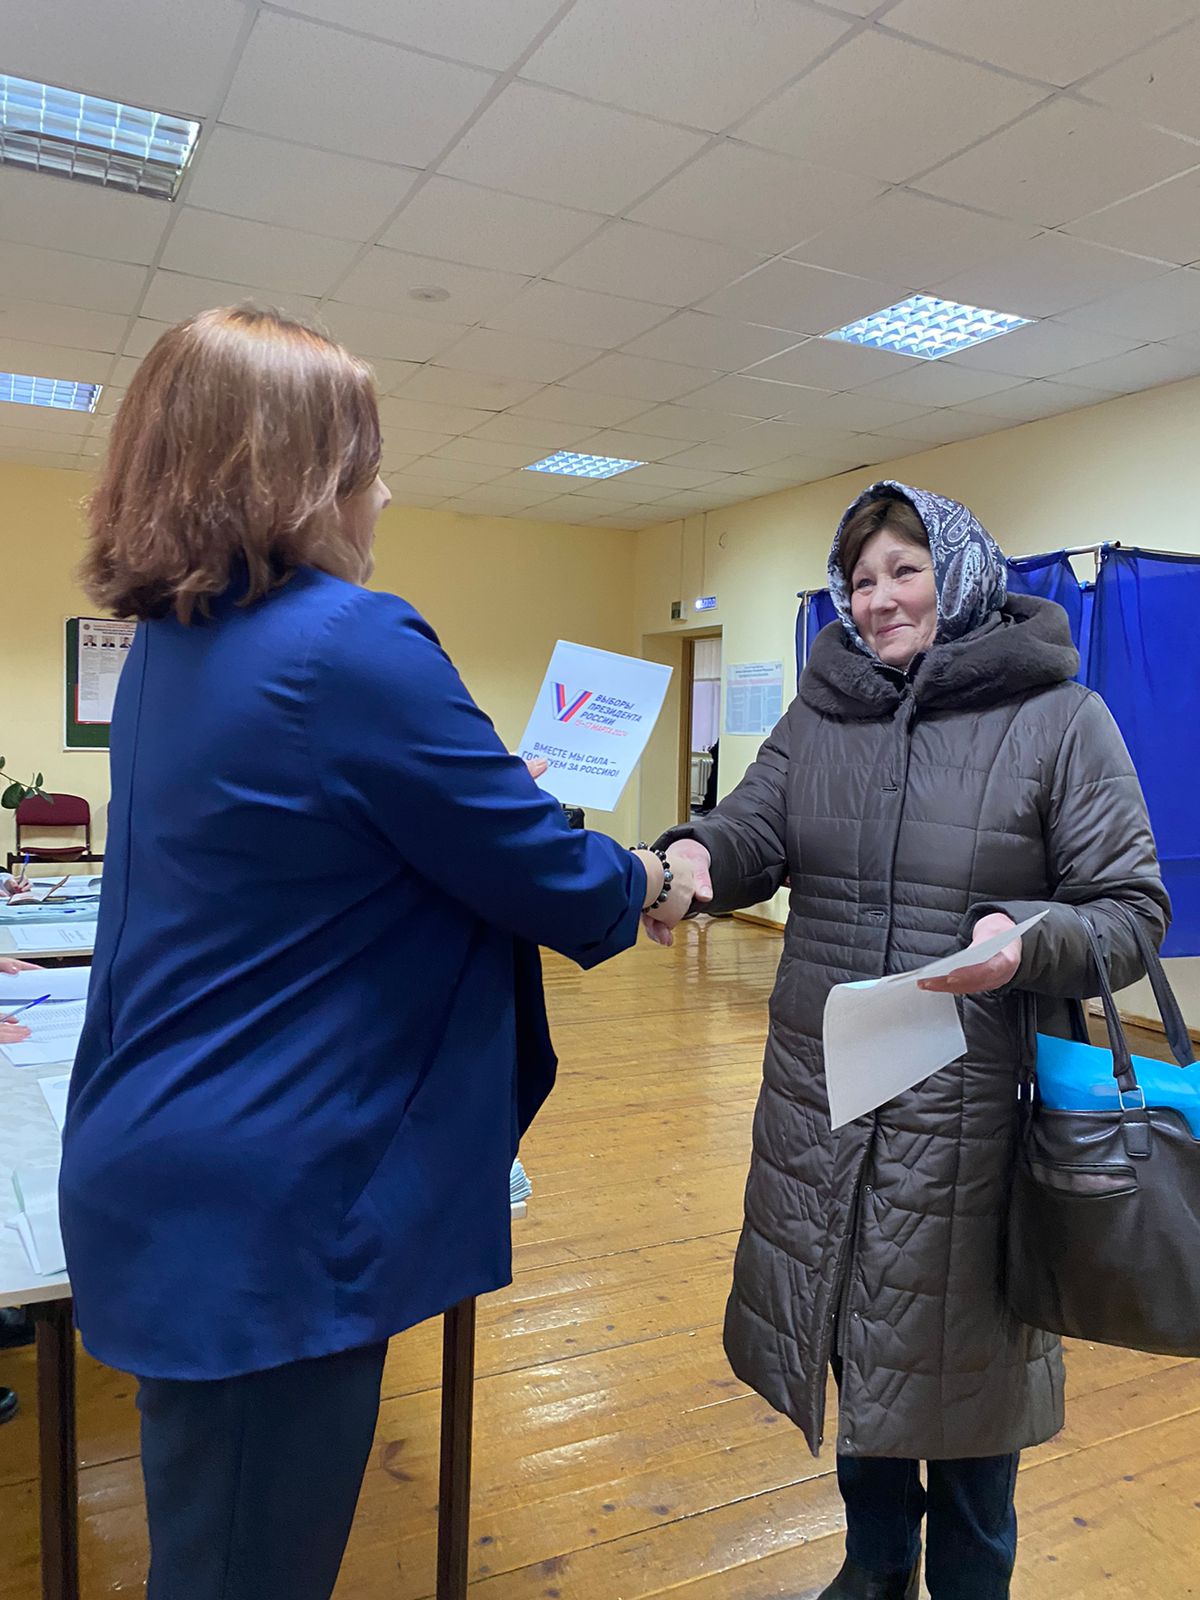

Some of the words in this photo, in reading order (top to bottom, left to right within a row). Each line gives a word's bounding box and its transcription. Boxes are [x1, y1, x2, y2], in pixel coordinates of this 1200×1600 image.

[595, 694, 635, 710] ВЫБОРЫ
[579, 711, 616, 726] РОССИИ
[587, 702, 642, 722] ПРЕЗИДЕНТА
[533, 742, 568, 759] ВМЕСТЕ
[568, 751, 585, 762] МЫ
[585, 755, 608, 766] СИЛА
[567, 762, 578, 772] ЗА
[579, 764, 620, 778] РОССИЮ!
